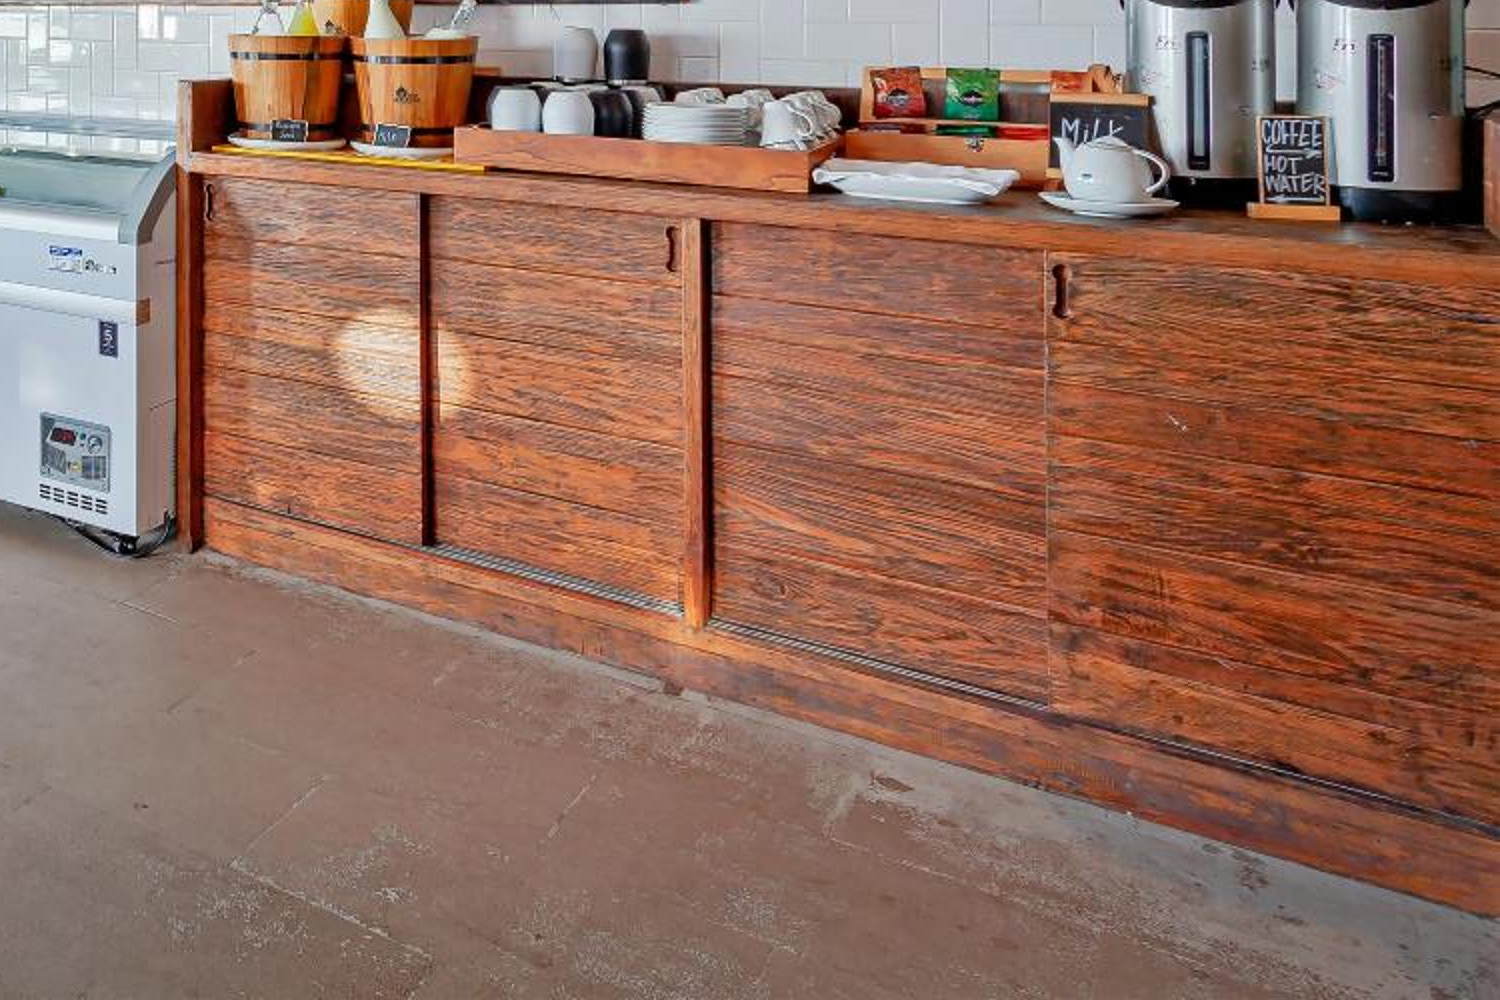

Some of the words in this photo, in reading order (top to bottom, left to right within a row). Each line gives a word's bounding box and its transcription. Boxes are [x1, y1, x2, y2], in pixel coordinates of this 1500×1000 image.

[1262, 119, 1322, 148] COFFEE
[1265, 155, 1299, 175] HOT
[1265, 173, 1326, 197] WATER
